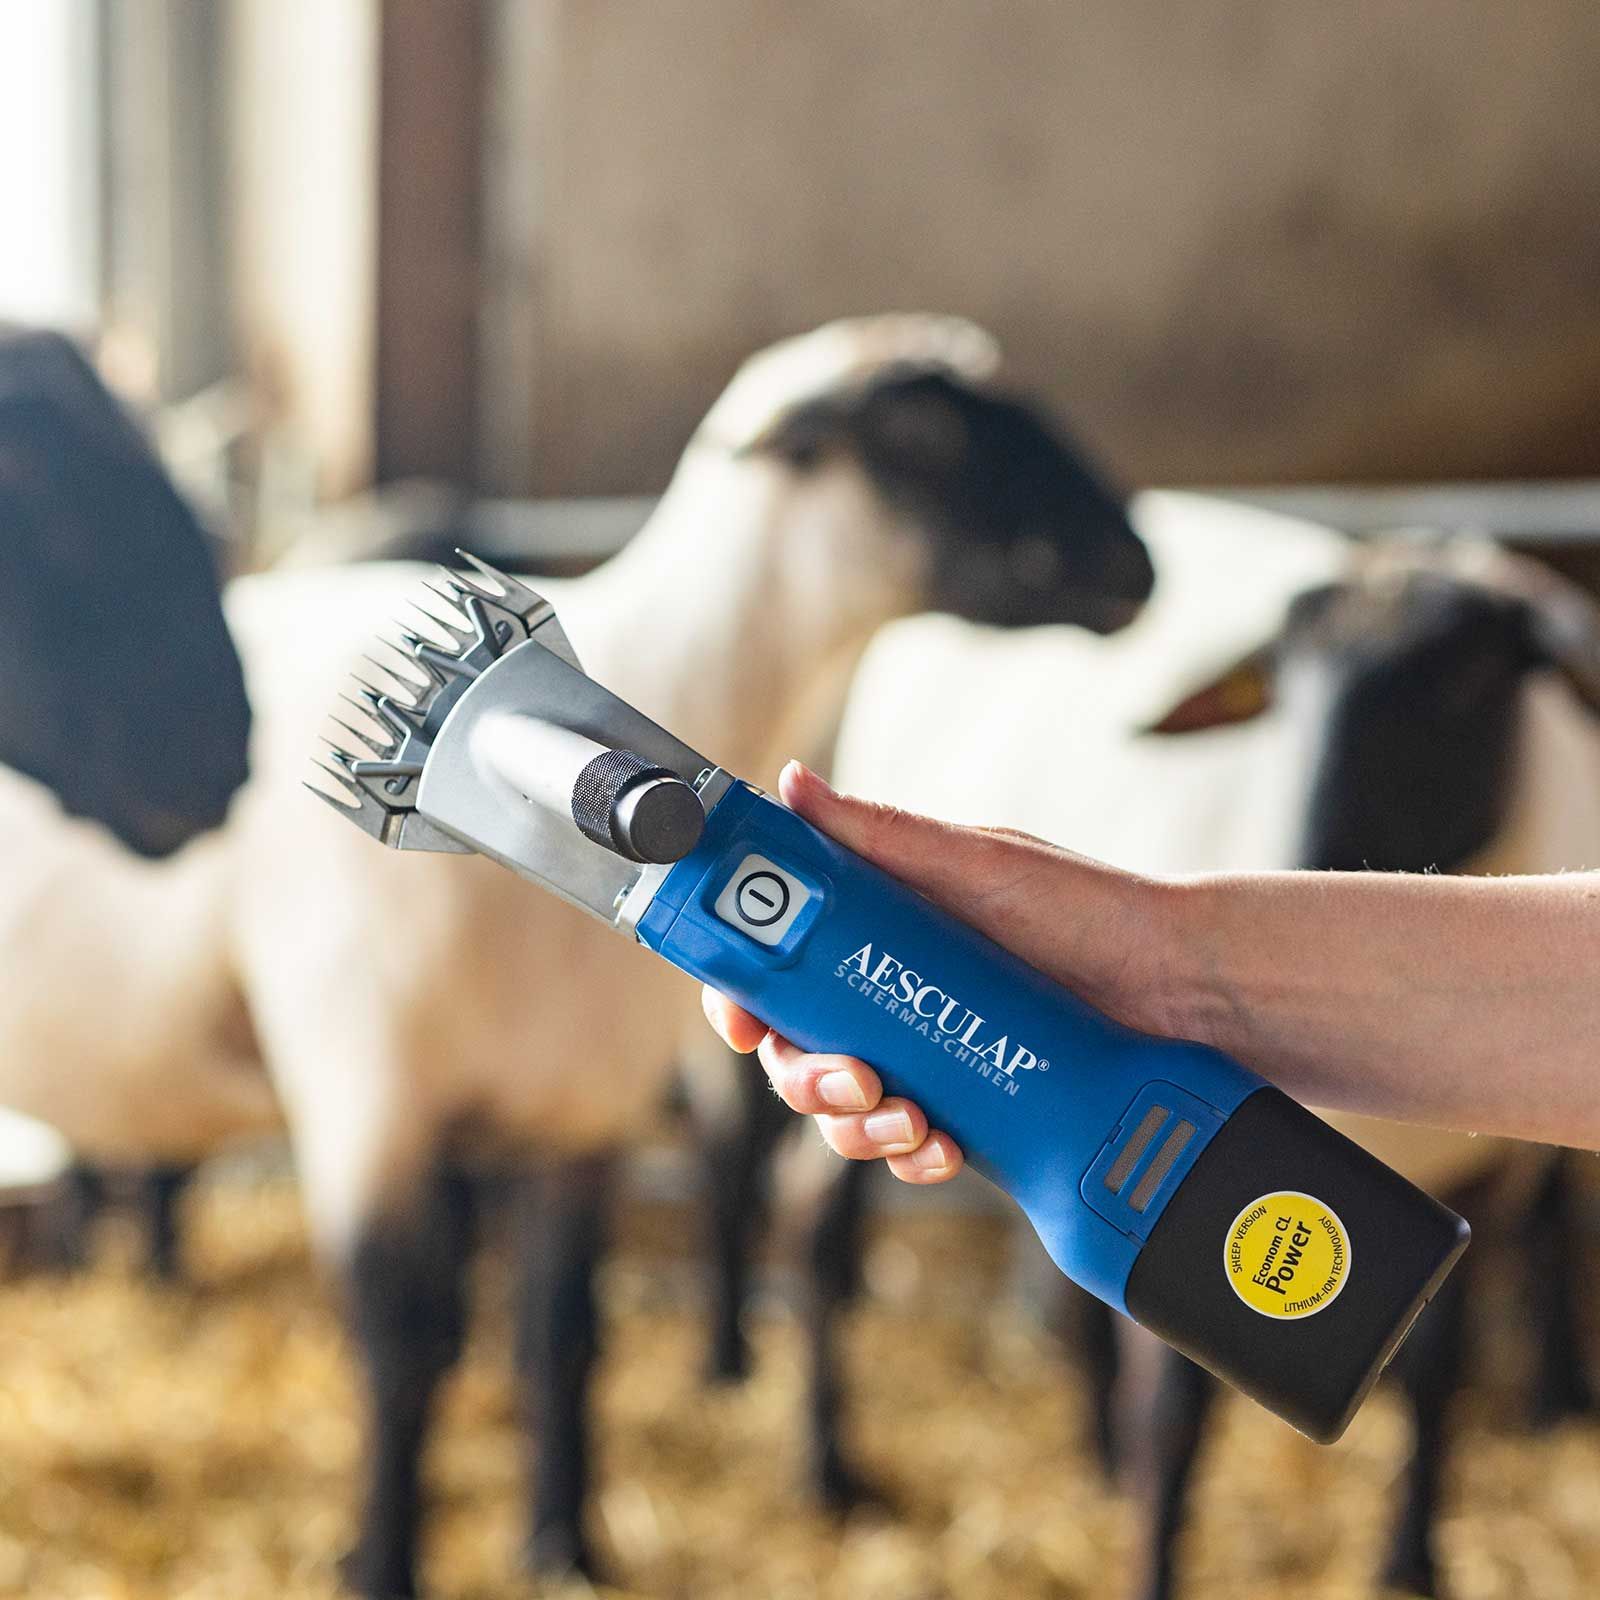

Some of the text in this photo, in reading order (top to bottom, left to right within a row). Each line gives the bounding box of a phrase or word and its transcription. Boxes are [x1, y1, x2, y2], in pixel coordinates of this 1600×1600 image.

[834, 964, 1021, 1096] SCHERMASCHINEN
[1231, 1205, 1267, 1274] SHEEP VERSION
[1252, 1215, 1292, 1286] Econom CL
[1265, 1220, 1313, 1295] Power
[1284, 1215, 1343, 1313] LITHIUM-ION TECHNOLOGY
